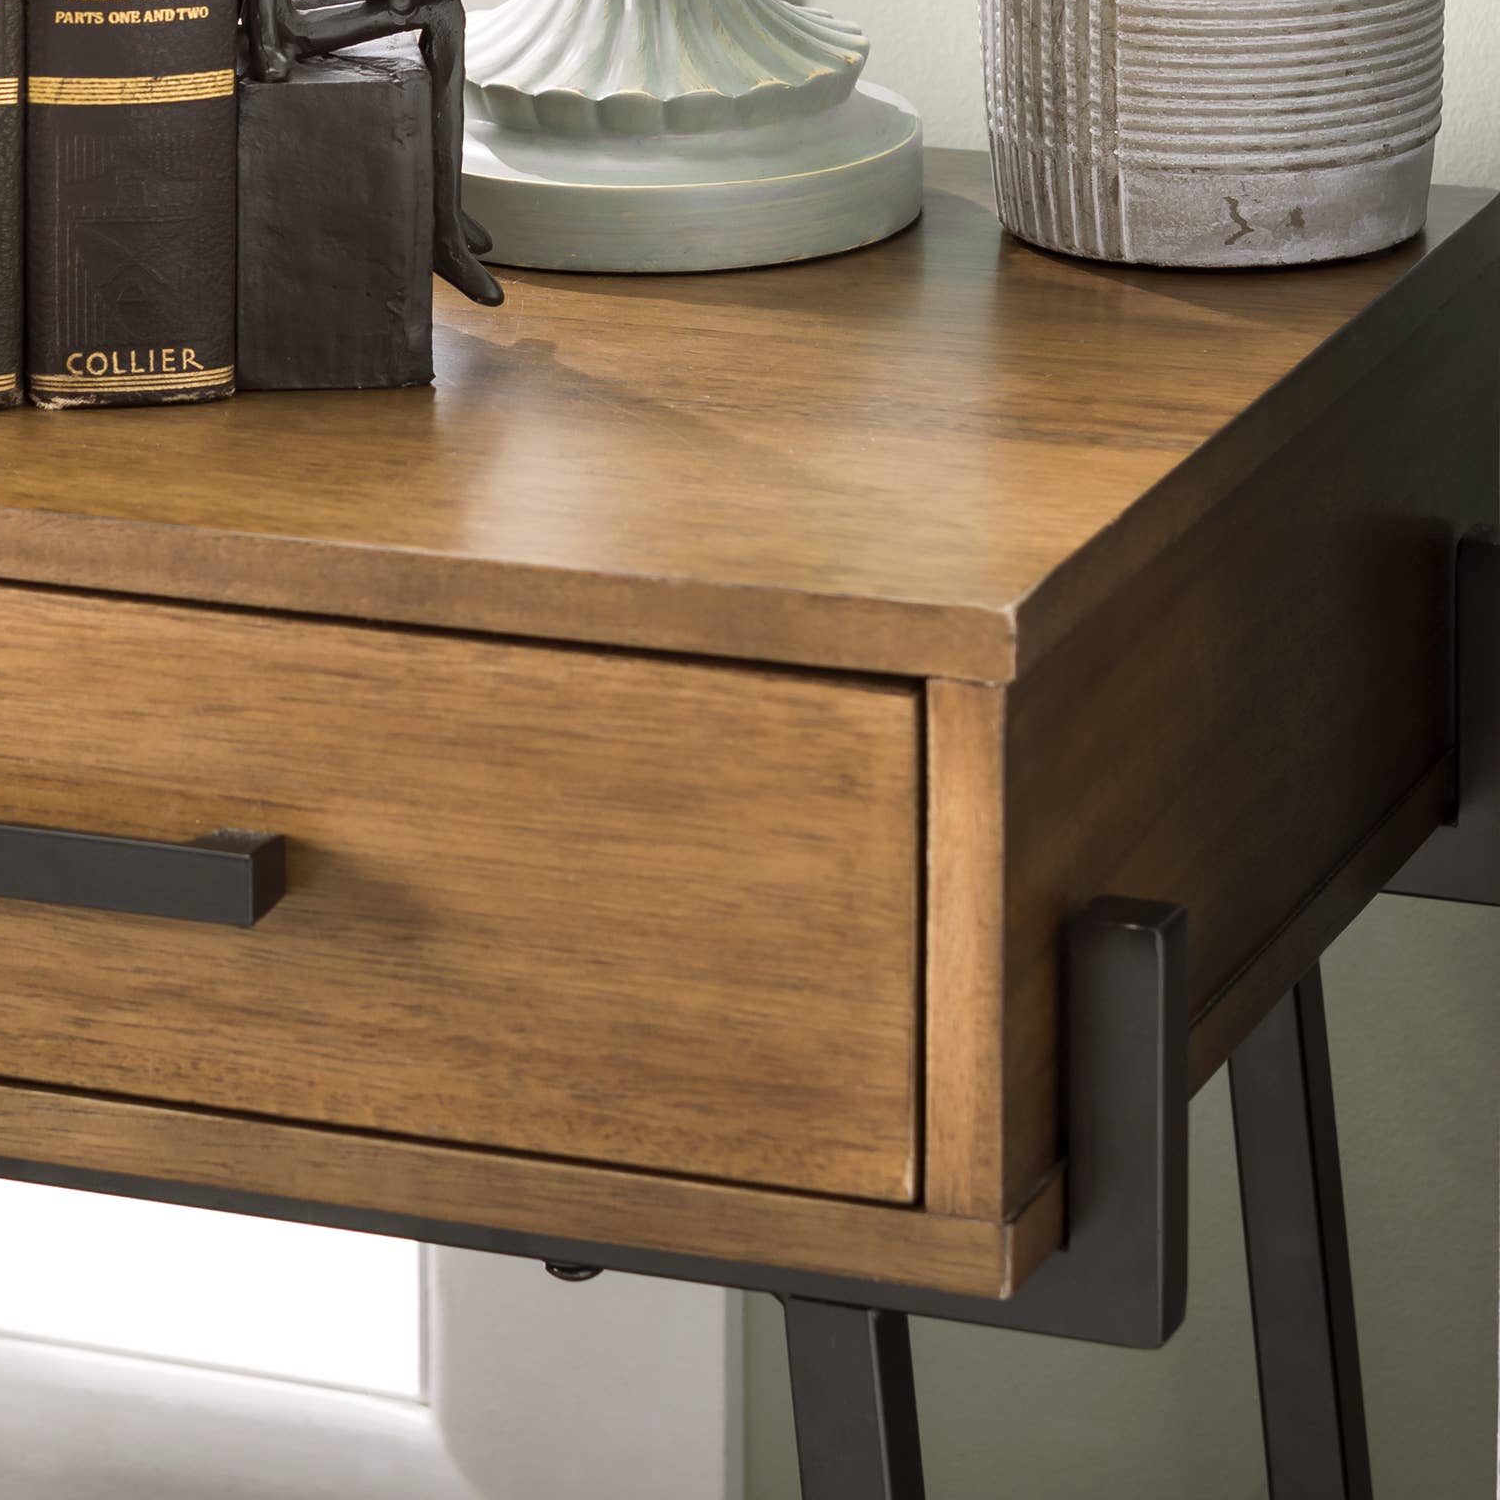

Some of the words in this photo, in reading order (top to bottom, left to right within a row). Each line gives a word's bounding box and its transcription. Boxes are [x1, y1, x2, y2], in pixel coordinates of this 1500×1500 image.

[55, 11, 104, 24] PARTS
[108, 11, 141, 24] ONE
[143, 8, 175, 22] AND
[176, 6, 209, 20] TWO
[66, 347, 205, 377] COLLIER
